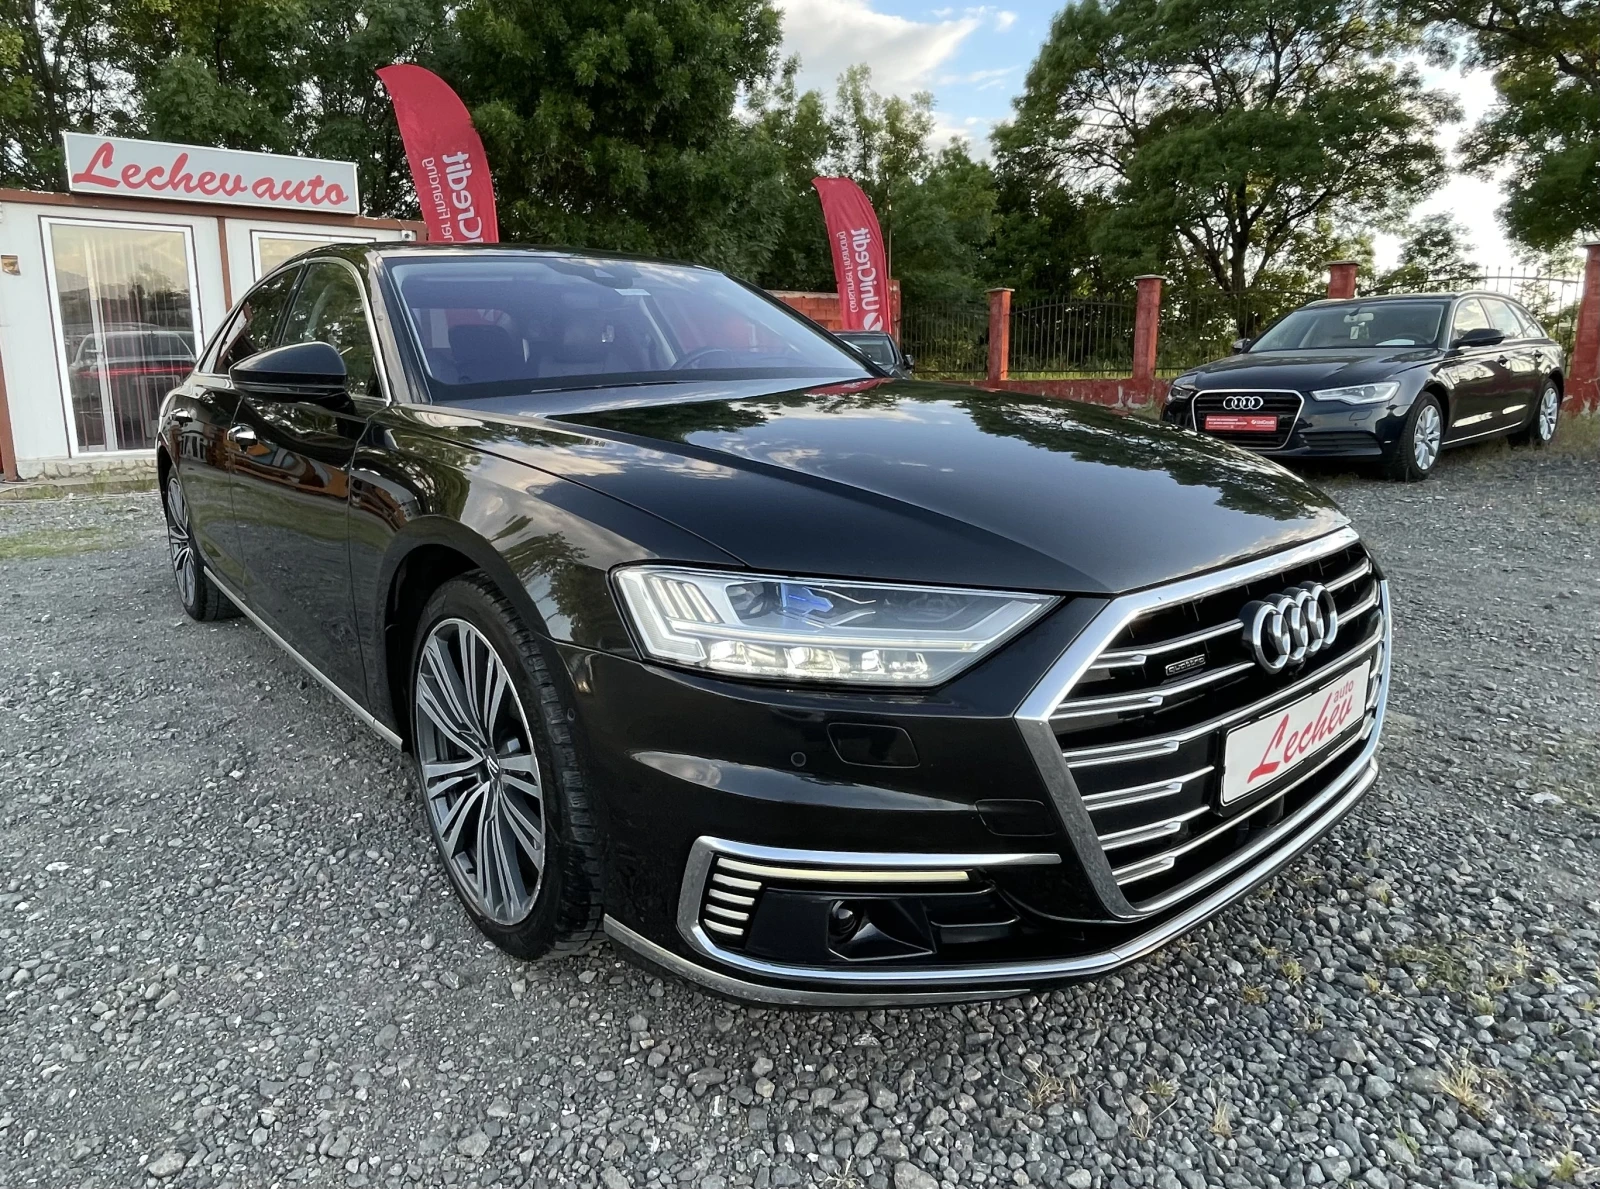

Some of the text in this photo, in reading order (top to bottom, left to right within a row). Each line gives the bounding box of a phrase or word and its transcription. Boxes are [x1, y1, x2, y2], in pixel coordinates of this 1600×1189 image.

[71, 141, 350, 206] Lechev auto
[1332, 679, 1355, 702] auto
[1246, 691, 1353, 784] Lechev
